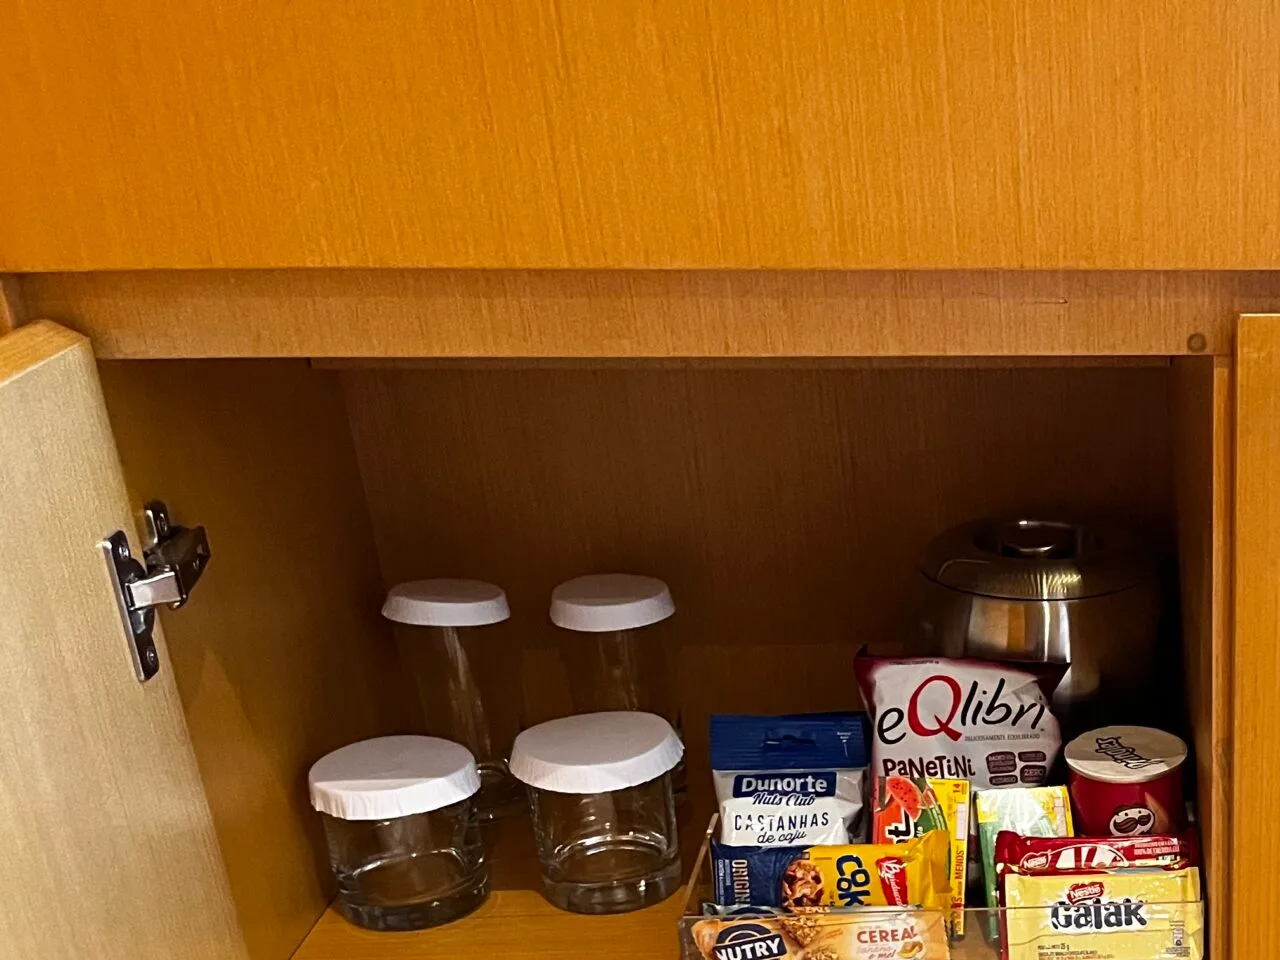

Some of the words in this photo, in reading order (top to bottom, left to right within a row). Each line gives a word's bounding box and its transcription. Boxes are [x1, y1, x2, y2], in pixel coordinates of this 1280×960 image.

[877, 675, 1046, 745] eQlibri
[1095, 736, 1165, 769] Pringles
[741, 775, 828, 793] Dunorte
[752, 792, 783, 806] Nuts
[786, 793, 816, 806] Club
[734, 812, 829, 831] CASTANHAS
[757, 831, 775, 844] de
[778, 830, 807, 843] caju
[955, 850, 965, 880] MENOS
[731, 859, 751, 905] ORIGIN
[1051, 898, 1148, 930] Galak
[857, 926, 918, 943] CEREAL
